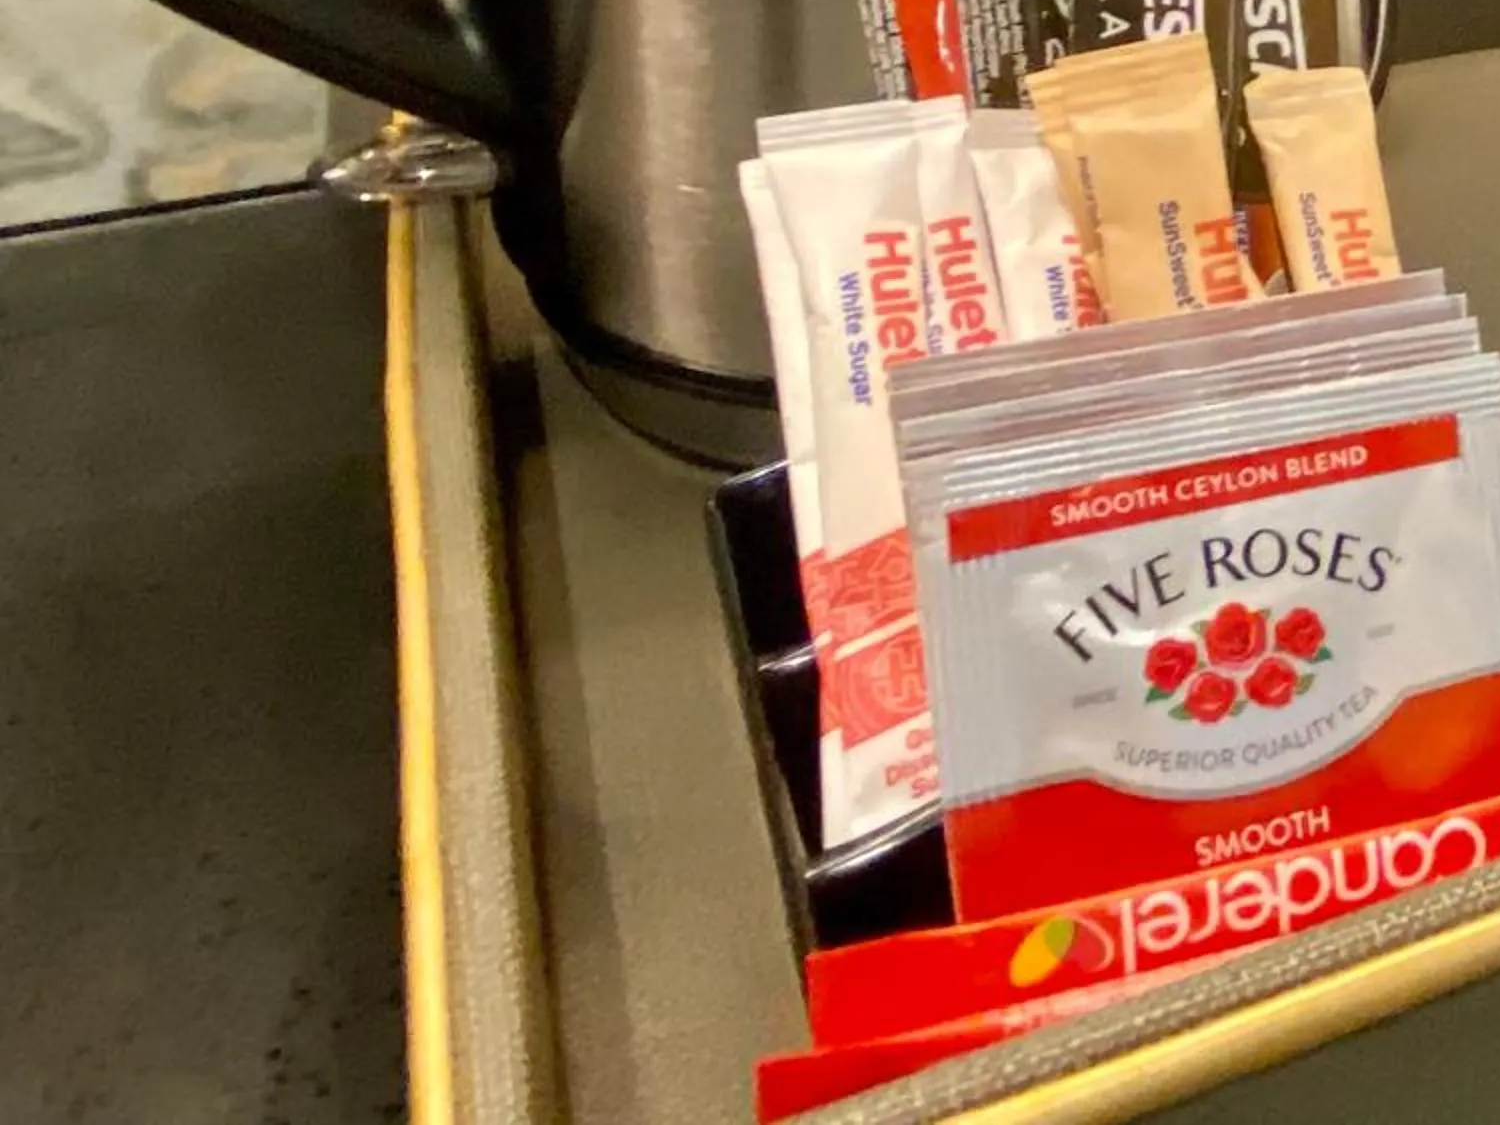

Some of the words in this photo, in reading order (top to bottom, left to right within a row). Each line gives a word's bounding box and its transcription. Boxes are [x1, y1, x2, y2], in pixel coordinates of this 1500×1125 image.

[1044, 265, 1070, 322] White
[1158, 200, 1197, 308] SunSweet
[839, 271, 865, 336] White
[848, 340, 872, 407] Sugar
[1049, 483, 1169, 527] SMOOTH
[1174, 462, 1280, 502] CEYLON
[1285, 444, 1370, 479] BLEND
[1053, 552, 1186, 664] FIVE
[1200, 527, 1394, 592] ROSES
[1113, 739, 1236, 774] SUPERIOR
[1241, 715, 1337, 765] QUALITY
[1338, 683, 1380, 720] TEA
[1194, 804, 1331, 867] SMOOTH
[1119, 816, 1487, 974] canderel
